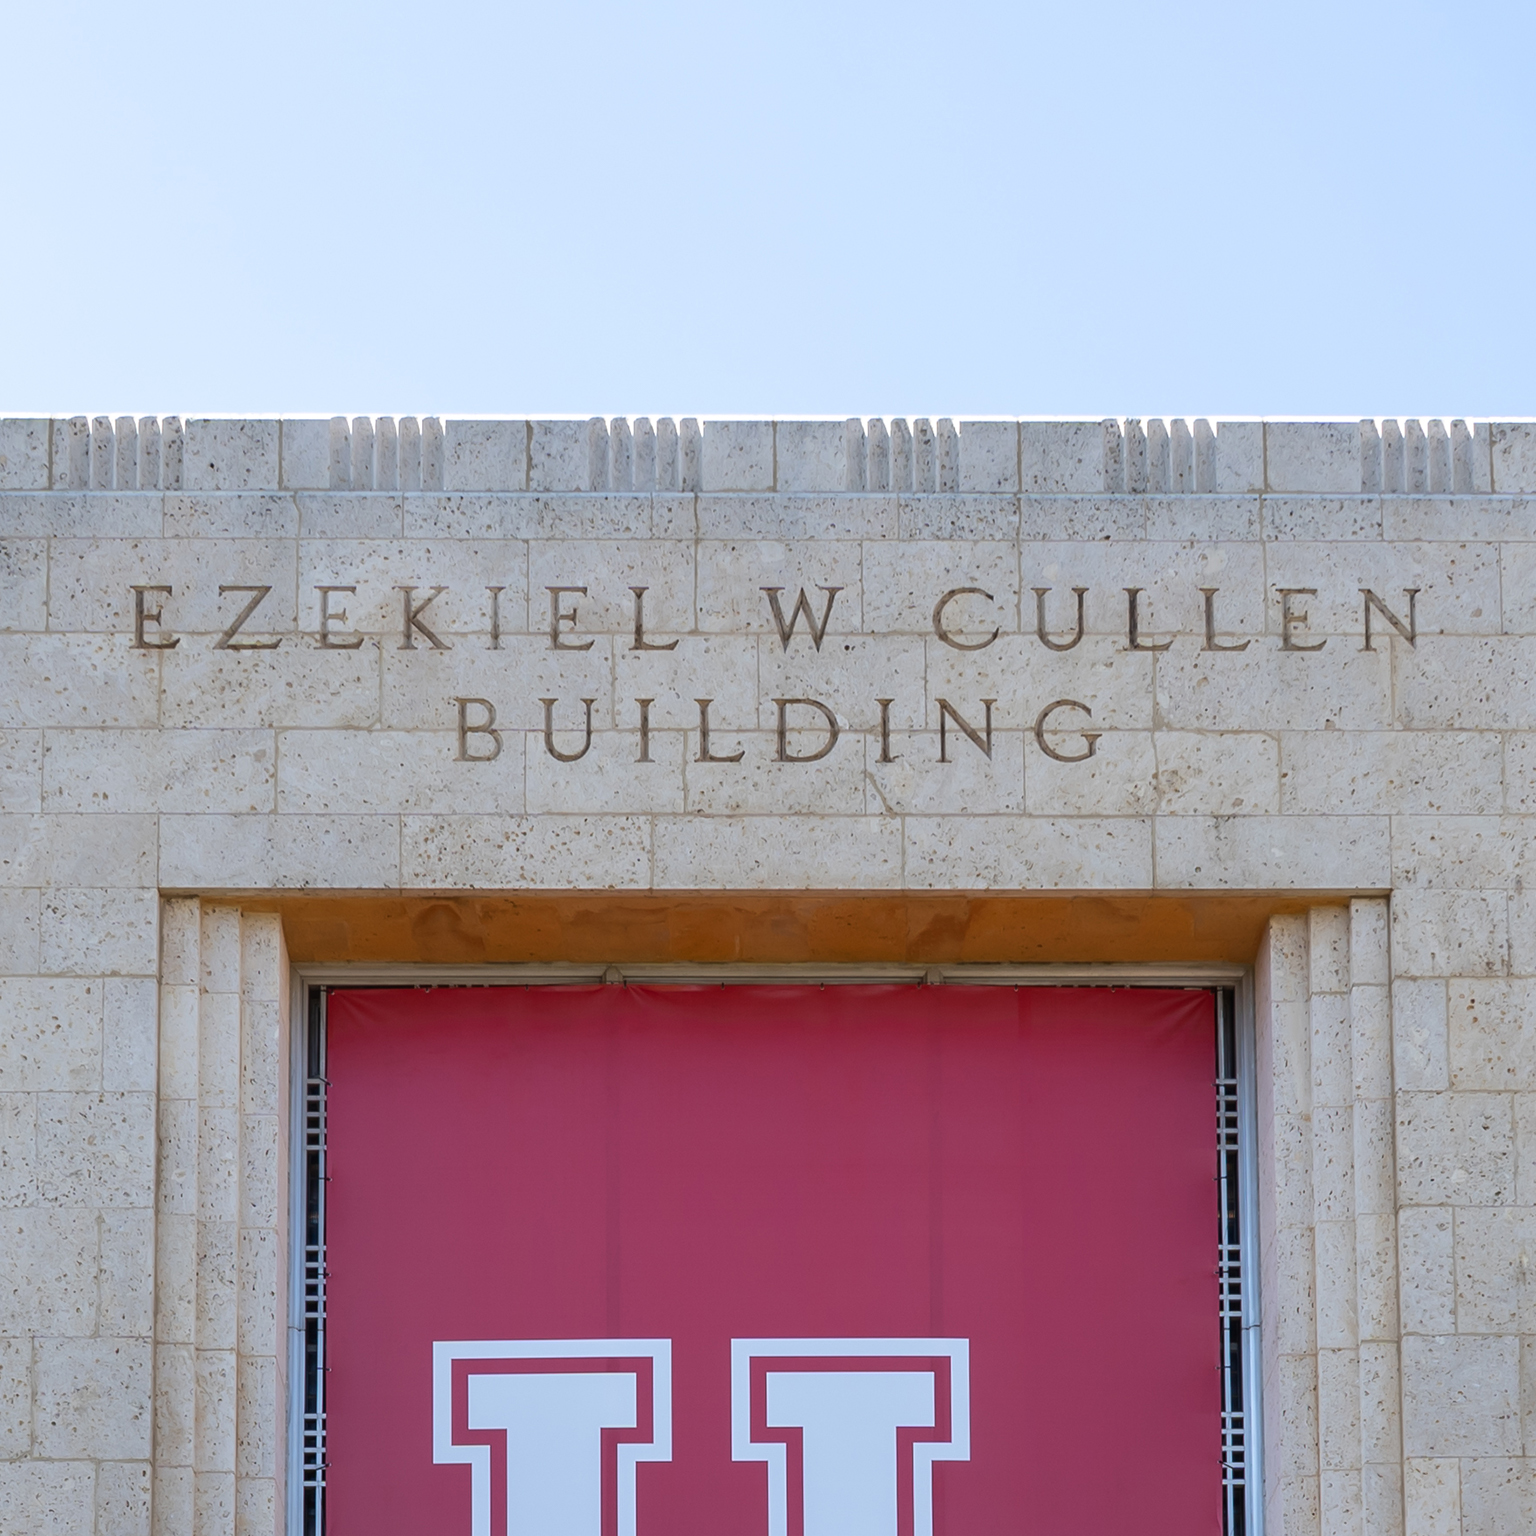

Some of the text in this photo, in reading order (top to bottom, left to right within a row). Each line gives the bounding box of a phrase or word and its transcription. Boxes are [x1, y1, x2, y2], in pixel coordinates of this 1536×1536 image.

[129, 585, 1421, 653] EZEKIEL W CULLEN
[454, 697, 1103, 764] BUILDING
